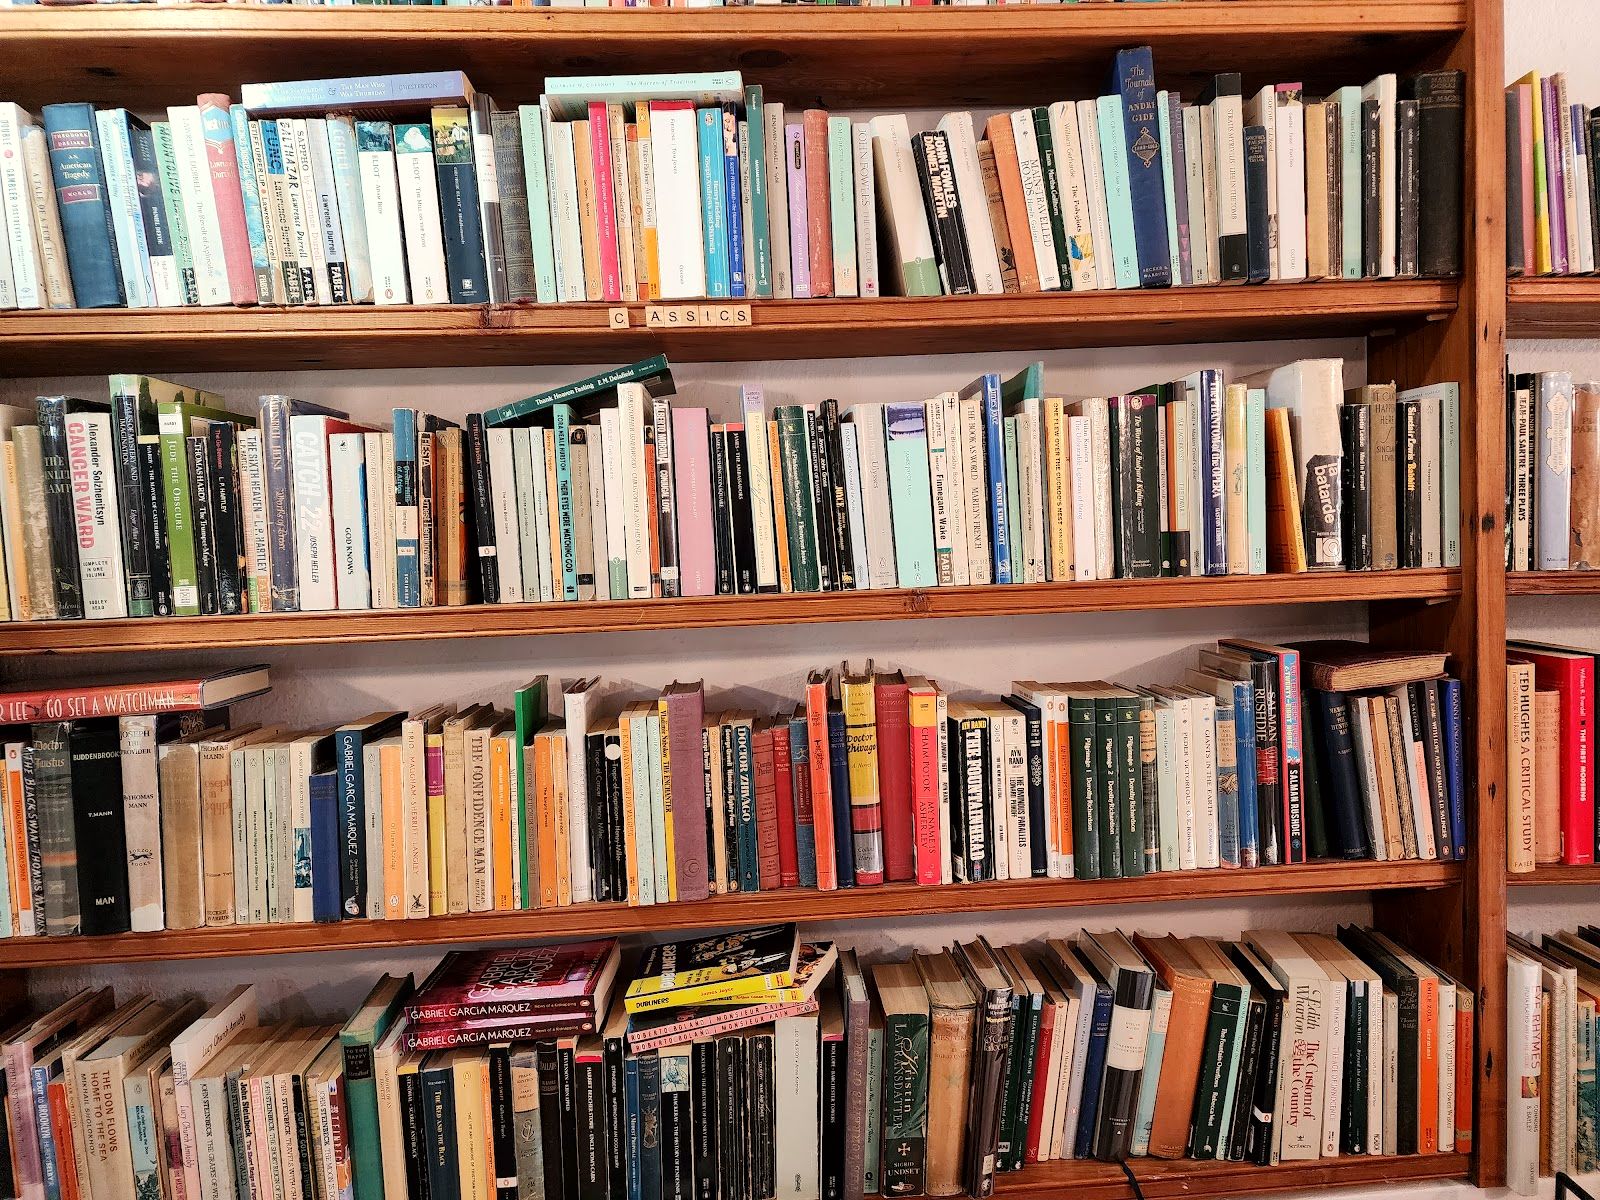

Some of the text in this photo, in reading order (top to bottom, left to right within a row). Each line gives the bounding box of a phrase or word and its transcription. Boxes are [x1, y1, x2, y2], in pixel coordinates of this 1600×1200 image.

[1130, 65, 1144, 77] The
[250, 123, 259, 146] STIFF
[1132, 113, 1155, 122] GIDE
[254, 147, 263, 172] UPPER
[922, 135, 948, 219] DANIEL MARTIN
[933, 135, 957, 209] JOHN FOWLES
[261, 197, 271, 233] Lawrence
[321, 194, 336, 255] Lawrence Durrell
[266, 235, 276, 261] Durrell
[331, 267, 343, 297] FABER
[535, 370, 635, 406] Thank Heaven Fasting E.M. Delafield
[146, 445, 154, 464] HARDY
[1135, 427, 1143, 446] Works
[68, 422, 95, 549] CANCER WARD
[87, 423, 106, 526] Alexander Solzhenitsyn
[167, 439, 183, 531] JUDE THE OBSCURE
[295, 431, 322, 531] CATCH-22
[1135, 455, 1144, 482] Rudyard
[1328, 463, 1338, 476] la
[151, 501, 158, 509] OF
[557, 414, 573, 573] ZORA NEALE HURSTON THEIR EYES WERE WATCHING GOD
[935, 474, 947, 541] Finnegans Wake
[1135, 483, 1144, 507] Kipling
[1314, 465, 1336, 524] batarde
[152, 509, 161, 550] CASTERBRIDGE
[345, 527, 354, 575] GOD KNOWS
[309, 535, 320, 584] JOSEPH HELLER
[941, 553, 951, 583] FABER
[10, 690, 176, 721] LEE GO SET A WATCHMAN
[660, 710, 668, 734] Vladimir
[1254, 687, 1267, 742] RUSHDIE
[1268, 691, 1277, 742] SALMAN
[661, 735, 669, 758] Nabokov
[847, 733, 873, 743] Doctor
[921, 727, 931, 792] CHAIM POTOK
[1126, 736, 1135, 766] Pilgrimage
[1518, 670, 1532, 853] TED HUGHES A CRITICAL STUDY
[1128, 778, 1136, 801] Dorothy
[1579, 729, 1587, 802] THE FIRST MODERNS
[343, 735, 357, 856] GABRIEL GARCÍA MÁRQUEZ
[471, 736, 486, 875] THE CONFIDENCE MAN
[664, 775, 672, 813] ENCHANTER
[966, 729, 985, 861] THE FOUNTAINHEAD
[1016, 776, 1027, 848] THE OMINOUS PARALLELS
[1129, 801, 1137, 833] Richardson
[1289, 769, 1300, 836] SALMAN RUSHDIE
[919, 801, 929, 849] ASHER LEV
[927, 801, 936, 854] MY NAME IS
[95, 896, 115, 906] MAN
[410, 1002, 531, 1020] GABRIEL GARCÍA MÁRQUEZ
[635, 997, 670, 1009] DUBLINERS
[1293, 985, 1310, 1035] Wharton
[1306, 990, 1322, 1030] Edith
[407, 1028, 531, 1048] GABRIEL GARCÍA MÁRQUEZ
[434, 1090, 442, 1103] THE
[892, 1023, 908, 1131] LAVRANSDATTER
[900, 1037, 919, 1113] Kristin
[1287, 1058, 1302, 1128] the Country
[1302, 1040, 1321, 1121] The Custom of
[34, 1068, 52, 1139] Last EXIT to BROOKLYN
[80, 1073, 95, 1157] MIKHAIL SHOLOKHOV
[90, 1071, 108, 1162] HOME TO THE SEA
[101, 1070, 118, 1152] THE DON FLOWS
[240, 1081, 252, 1137] John Steinbeck
[435, 1104, 443, 1119] RED
[297, 1112, 308, 1158] CUP OF GOLD
[438, 1146, 446, 1167] BLACK
